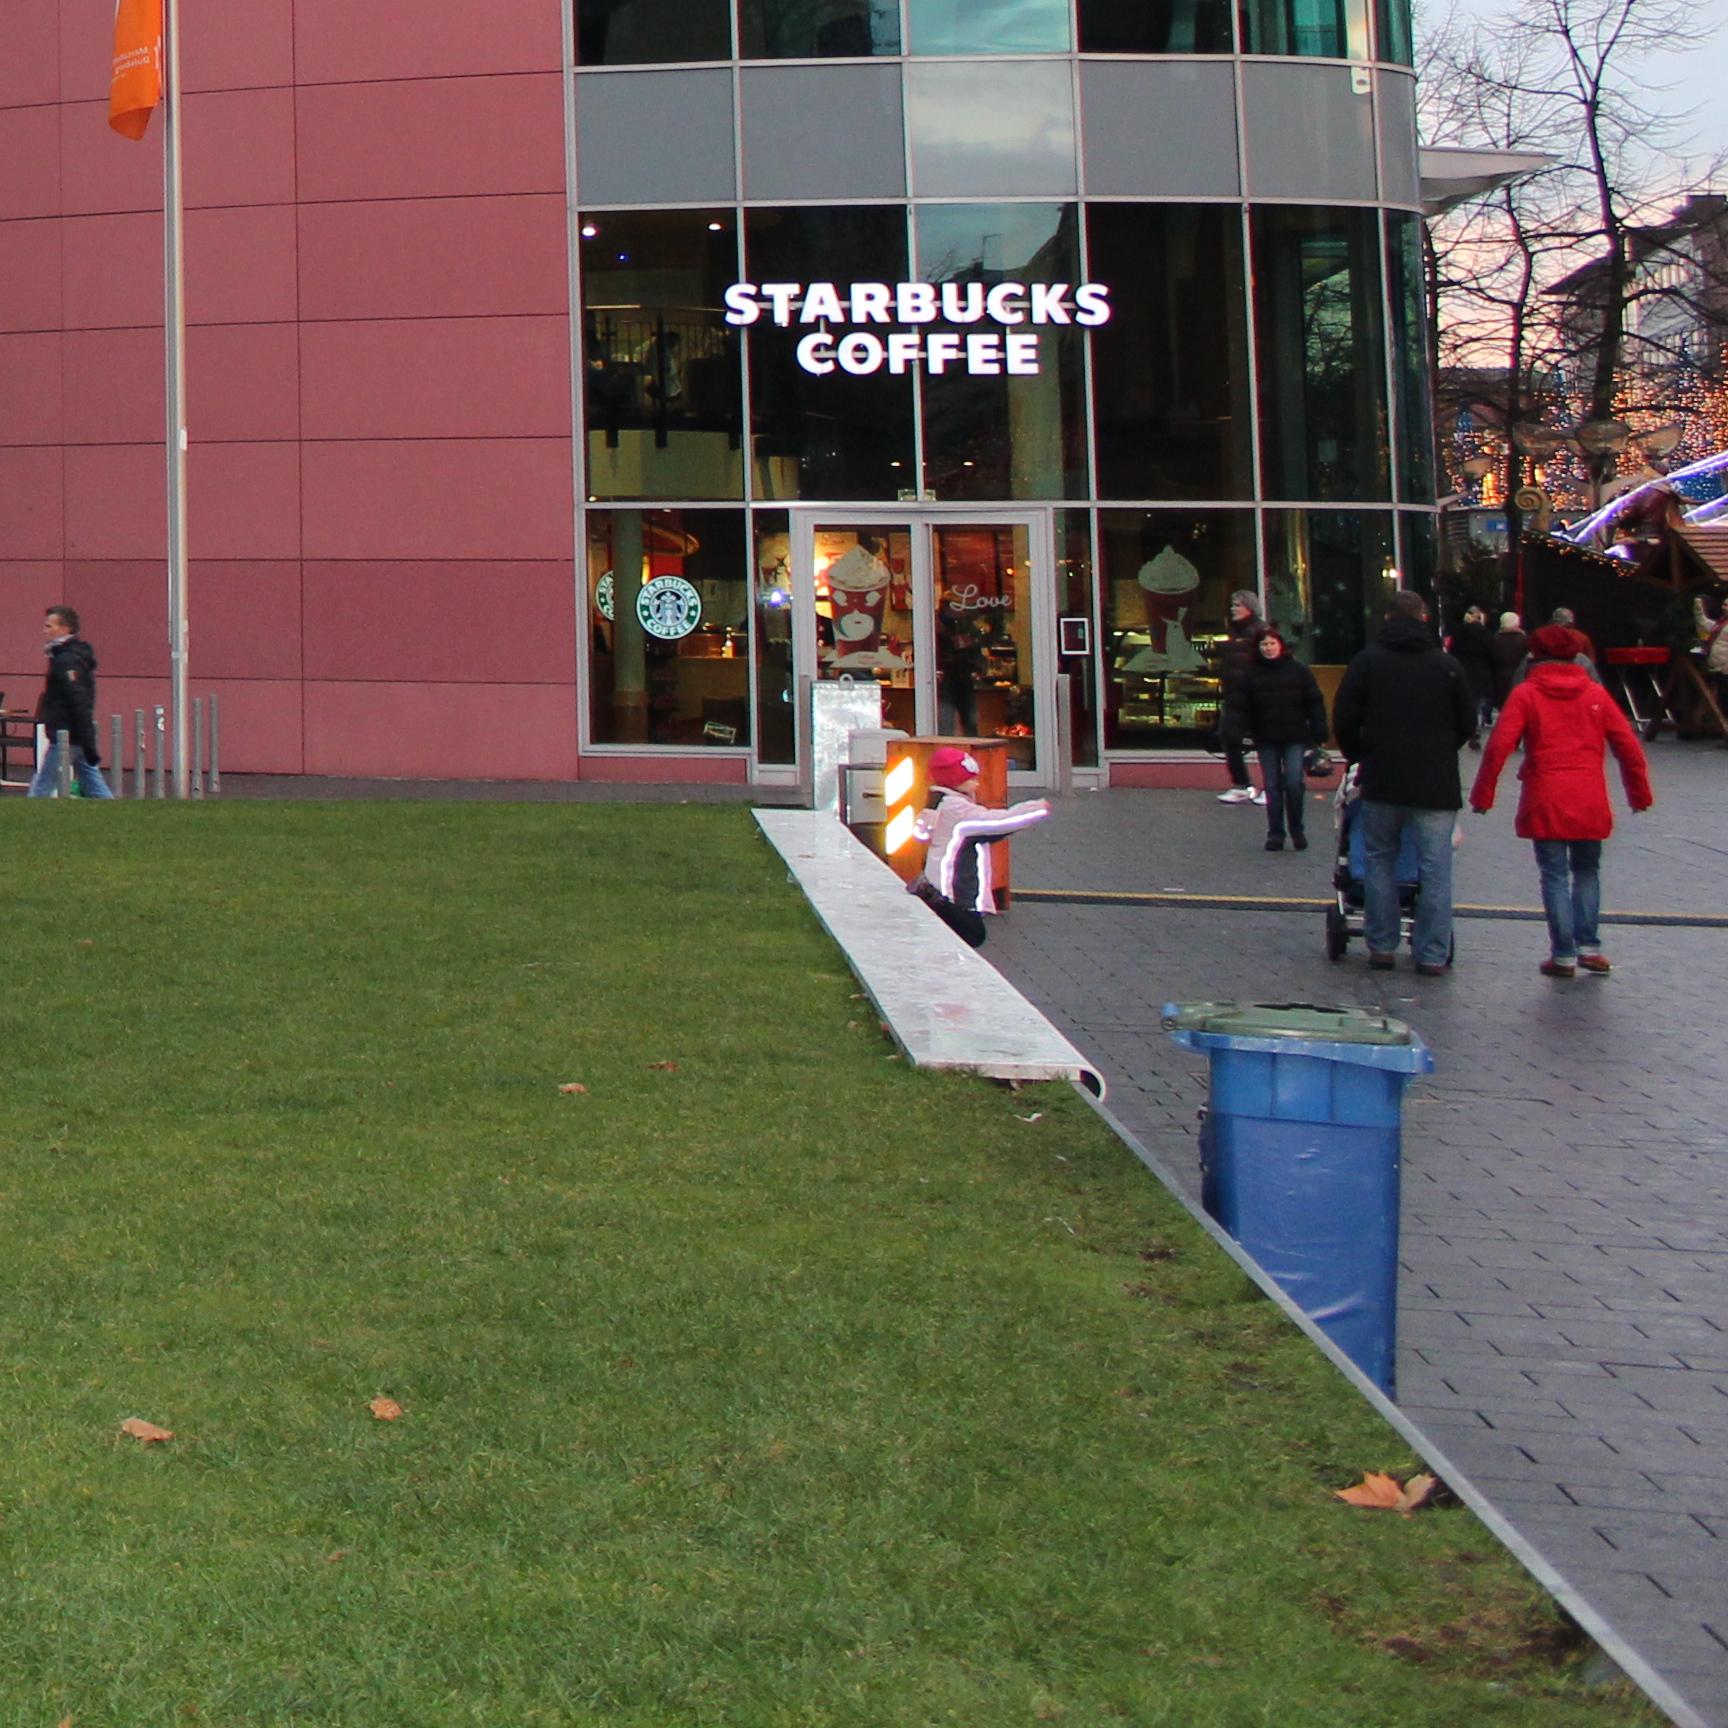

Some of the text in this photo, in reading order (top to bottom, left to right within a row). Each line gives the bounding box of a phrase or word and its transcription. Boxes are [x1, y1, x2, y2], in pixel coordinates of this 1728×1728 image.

[724, 282, 1112, 327] STARBUCKS
[796, 332, 1040, 376] COFFEE
[640, 578, 698, 607] STARBUCKS
[949, 583, 1013, 612] Love
[646, 618, 692, 637] COFFEE
